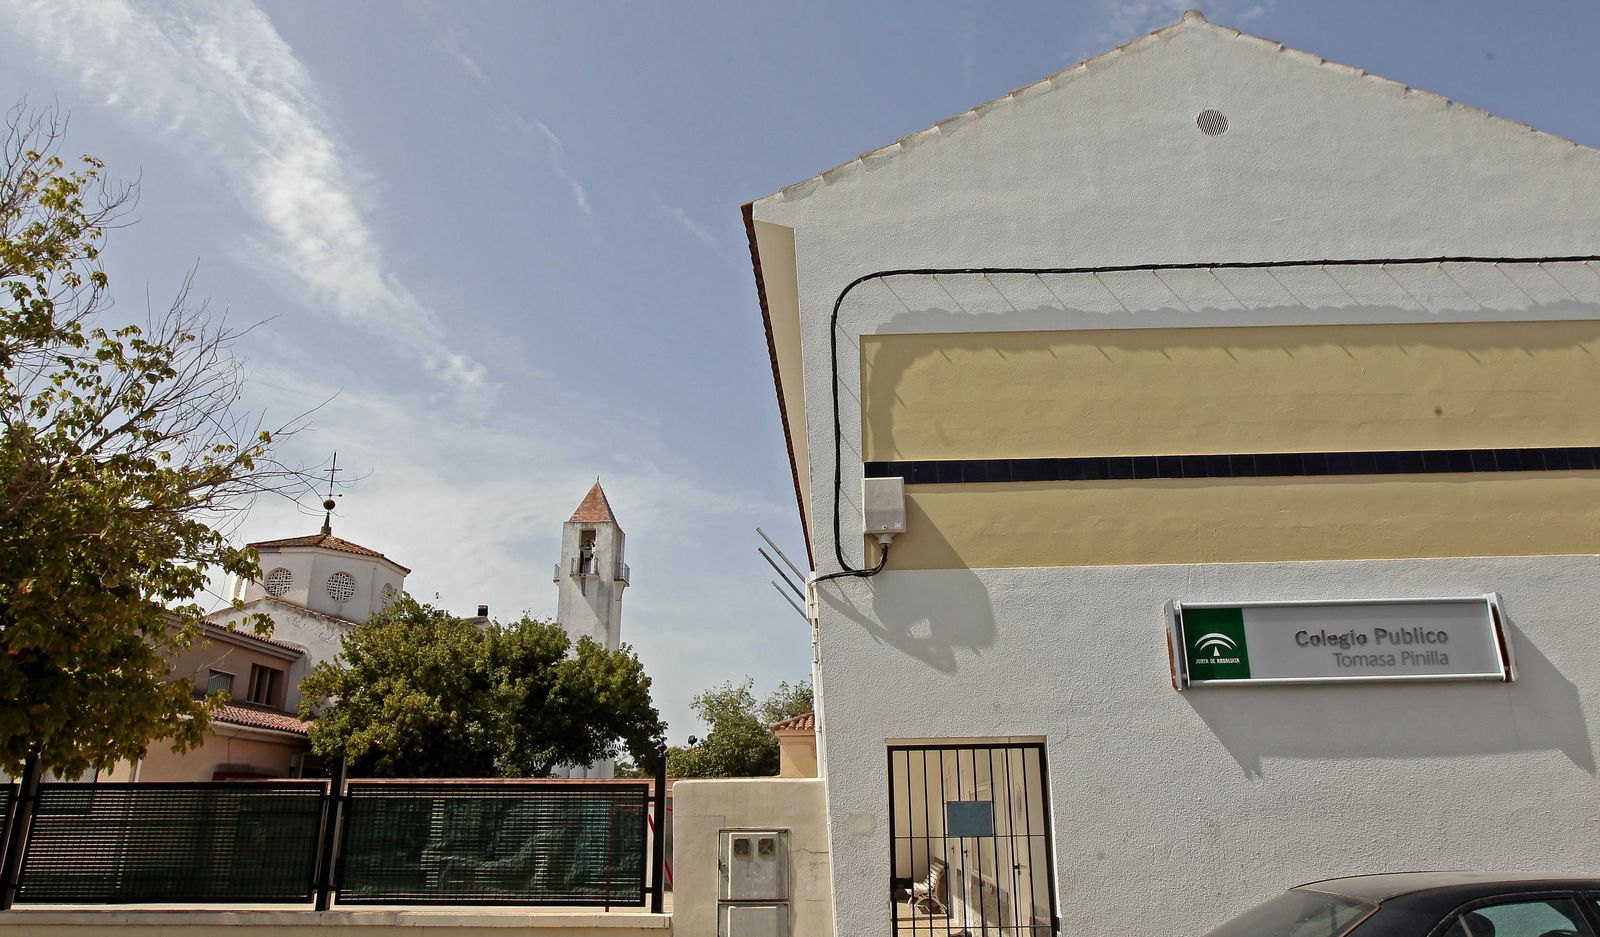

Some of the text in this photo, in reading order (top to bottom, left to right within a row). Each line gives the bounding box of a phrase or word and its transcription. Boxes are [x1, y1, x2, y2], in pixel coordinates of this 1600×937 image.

[1295, 627, 1448, 650] Colegio Publico
[1333, 650, 1449, 668] Tomasa Pinilla
